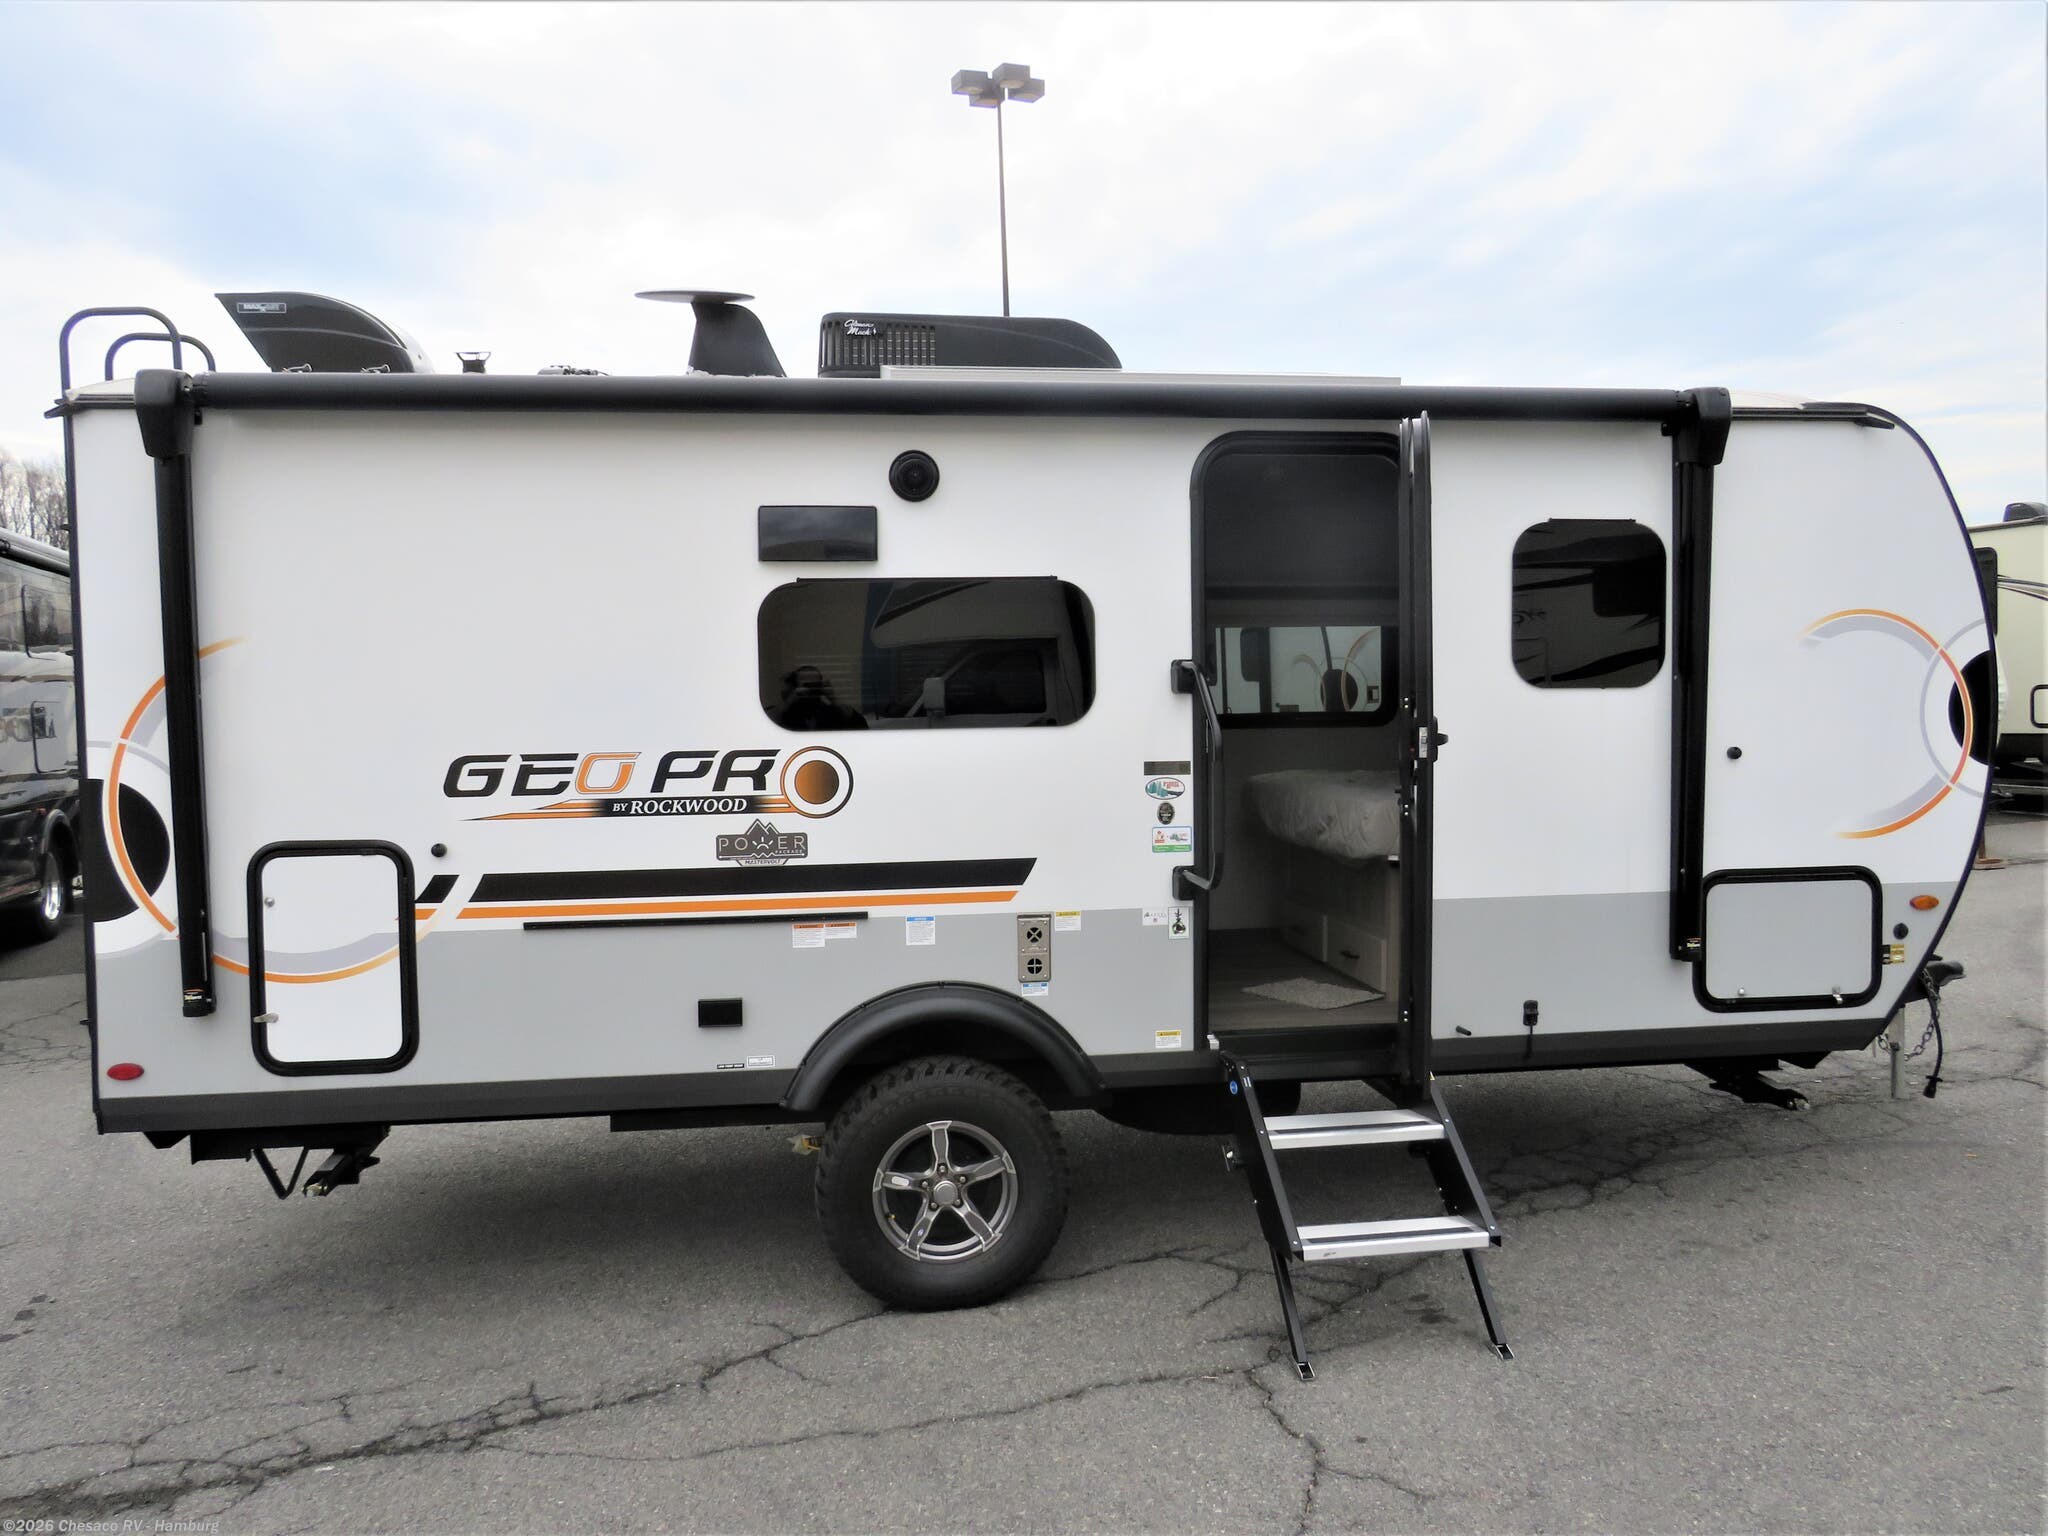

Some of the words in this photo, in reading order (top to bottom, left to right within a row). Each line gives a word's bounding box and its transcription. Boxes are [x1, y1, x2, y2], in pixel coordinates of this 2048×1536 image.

[443, 752, 642, 798] GEO
[650, 746, 854, 819] PRO
[612, 803, 628, 812] BY
[629, 798, 747, 814] ROCKWOOD
